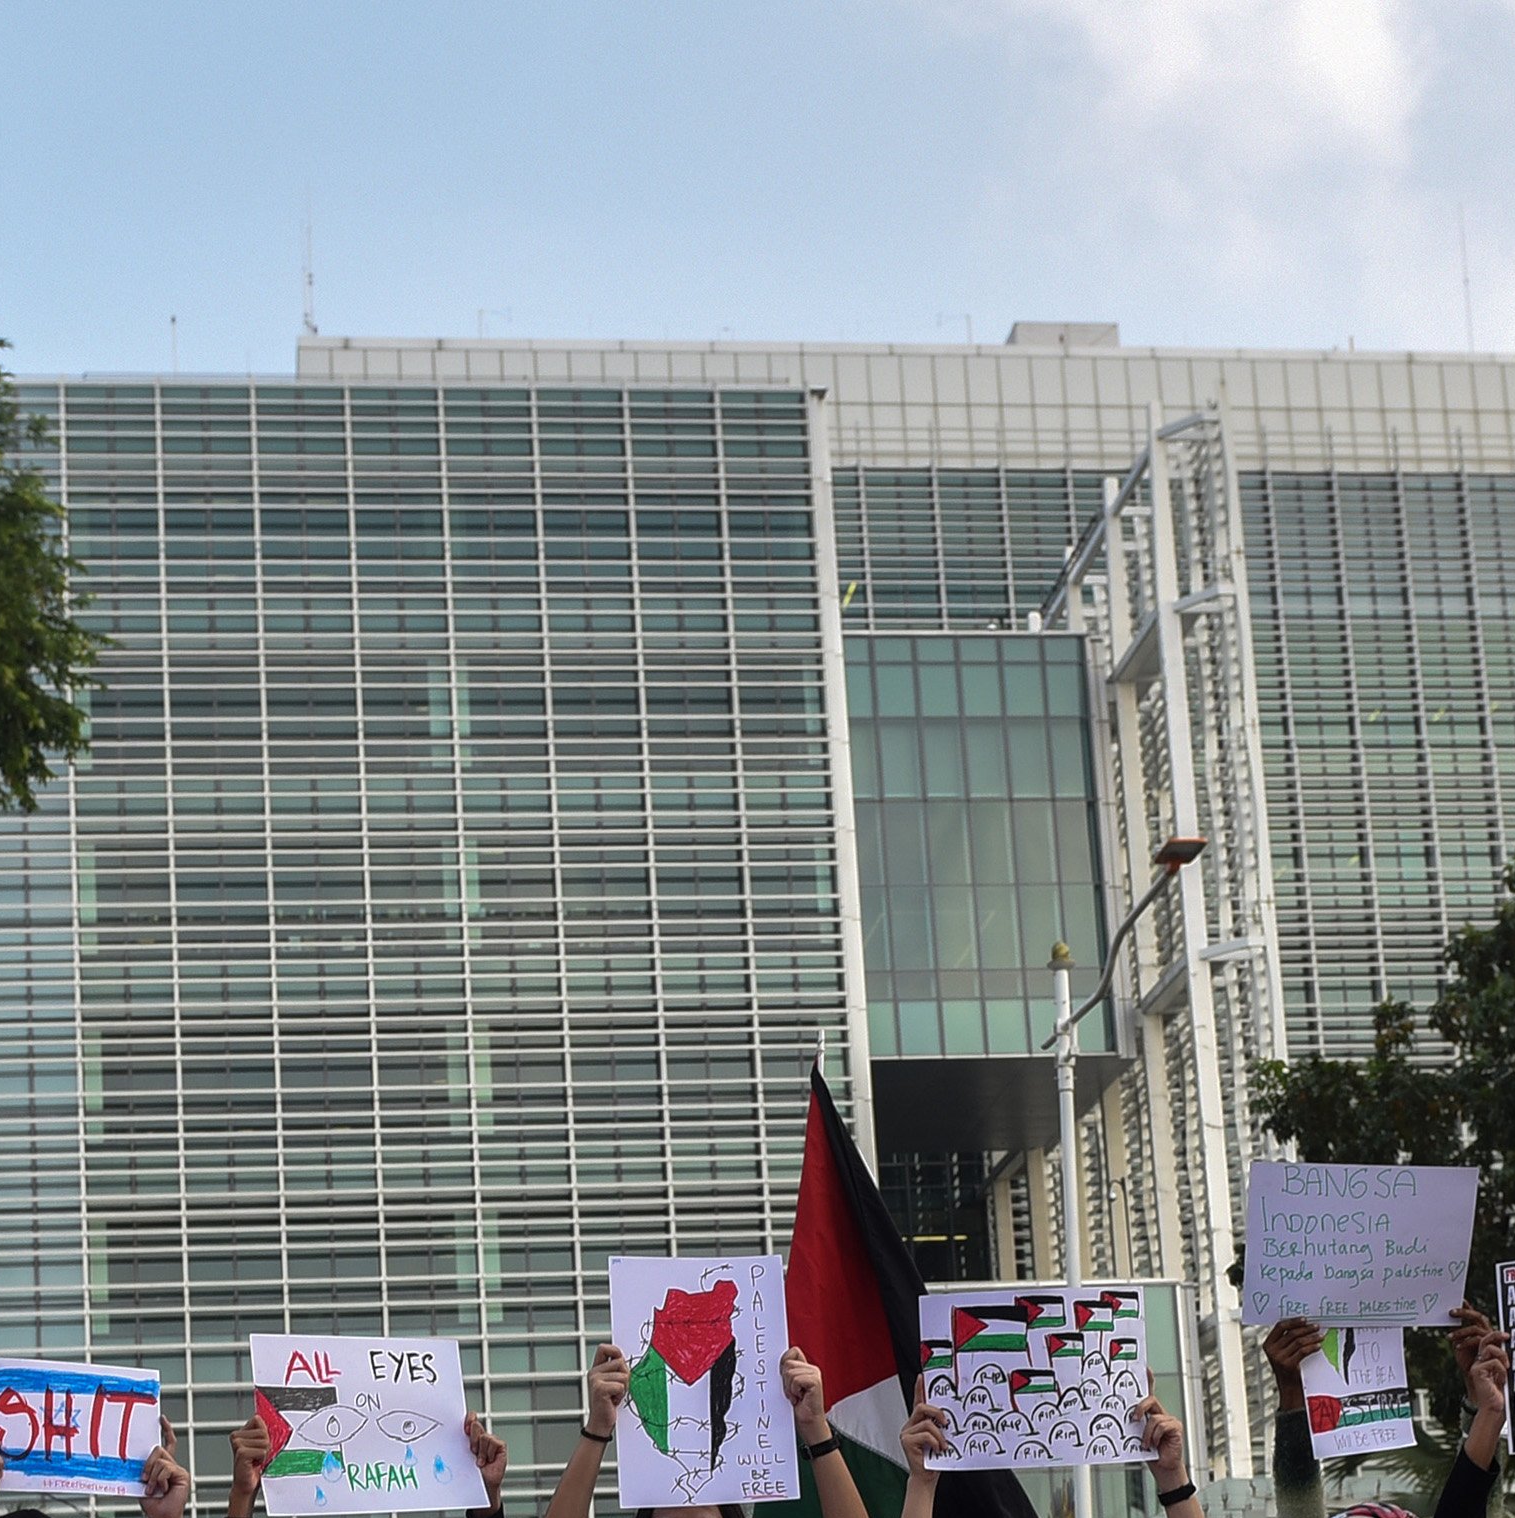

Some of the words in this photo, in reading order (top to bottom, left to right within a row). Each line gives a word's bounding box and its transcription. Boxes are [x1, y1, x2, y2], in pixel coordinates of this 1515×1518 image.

[1282, 1166, 1417, 1199] BANGSA
[750, 1265, 773, 1448] PALESTINE
[1357, 1341, 1380, 1366] TO
[285, 1350, 341, 1385] ALL
[369, 1351, 437, 1385] EYES
[934, 1384, 951, 1395] RIP
[356, 1393, 380, 1411] ON
[970, 1392, 987, 1404] RIP
[1001, 1419, 1022, 1432] RIP
[969, 1440, 989, 1455] RIP
[1024, 1449, 1044, 1459] RIP
[1093, 1445, 1107, 1456] RIP
[738, 1454, 786, 1465] WILL
[347, 1462, 419, 1492] RAFAH
[751, 1469, 770, 1479] BE
[742, 1481, 787, 1495] FREE
